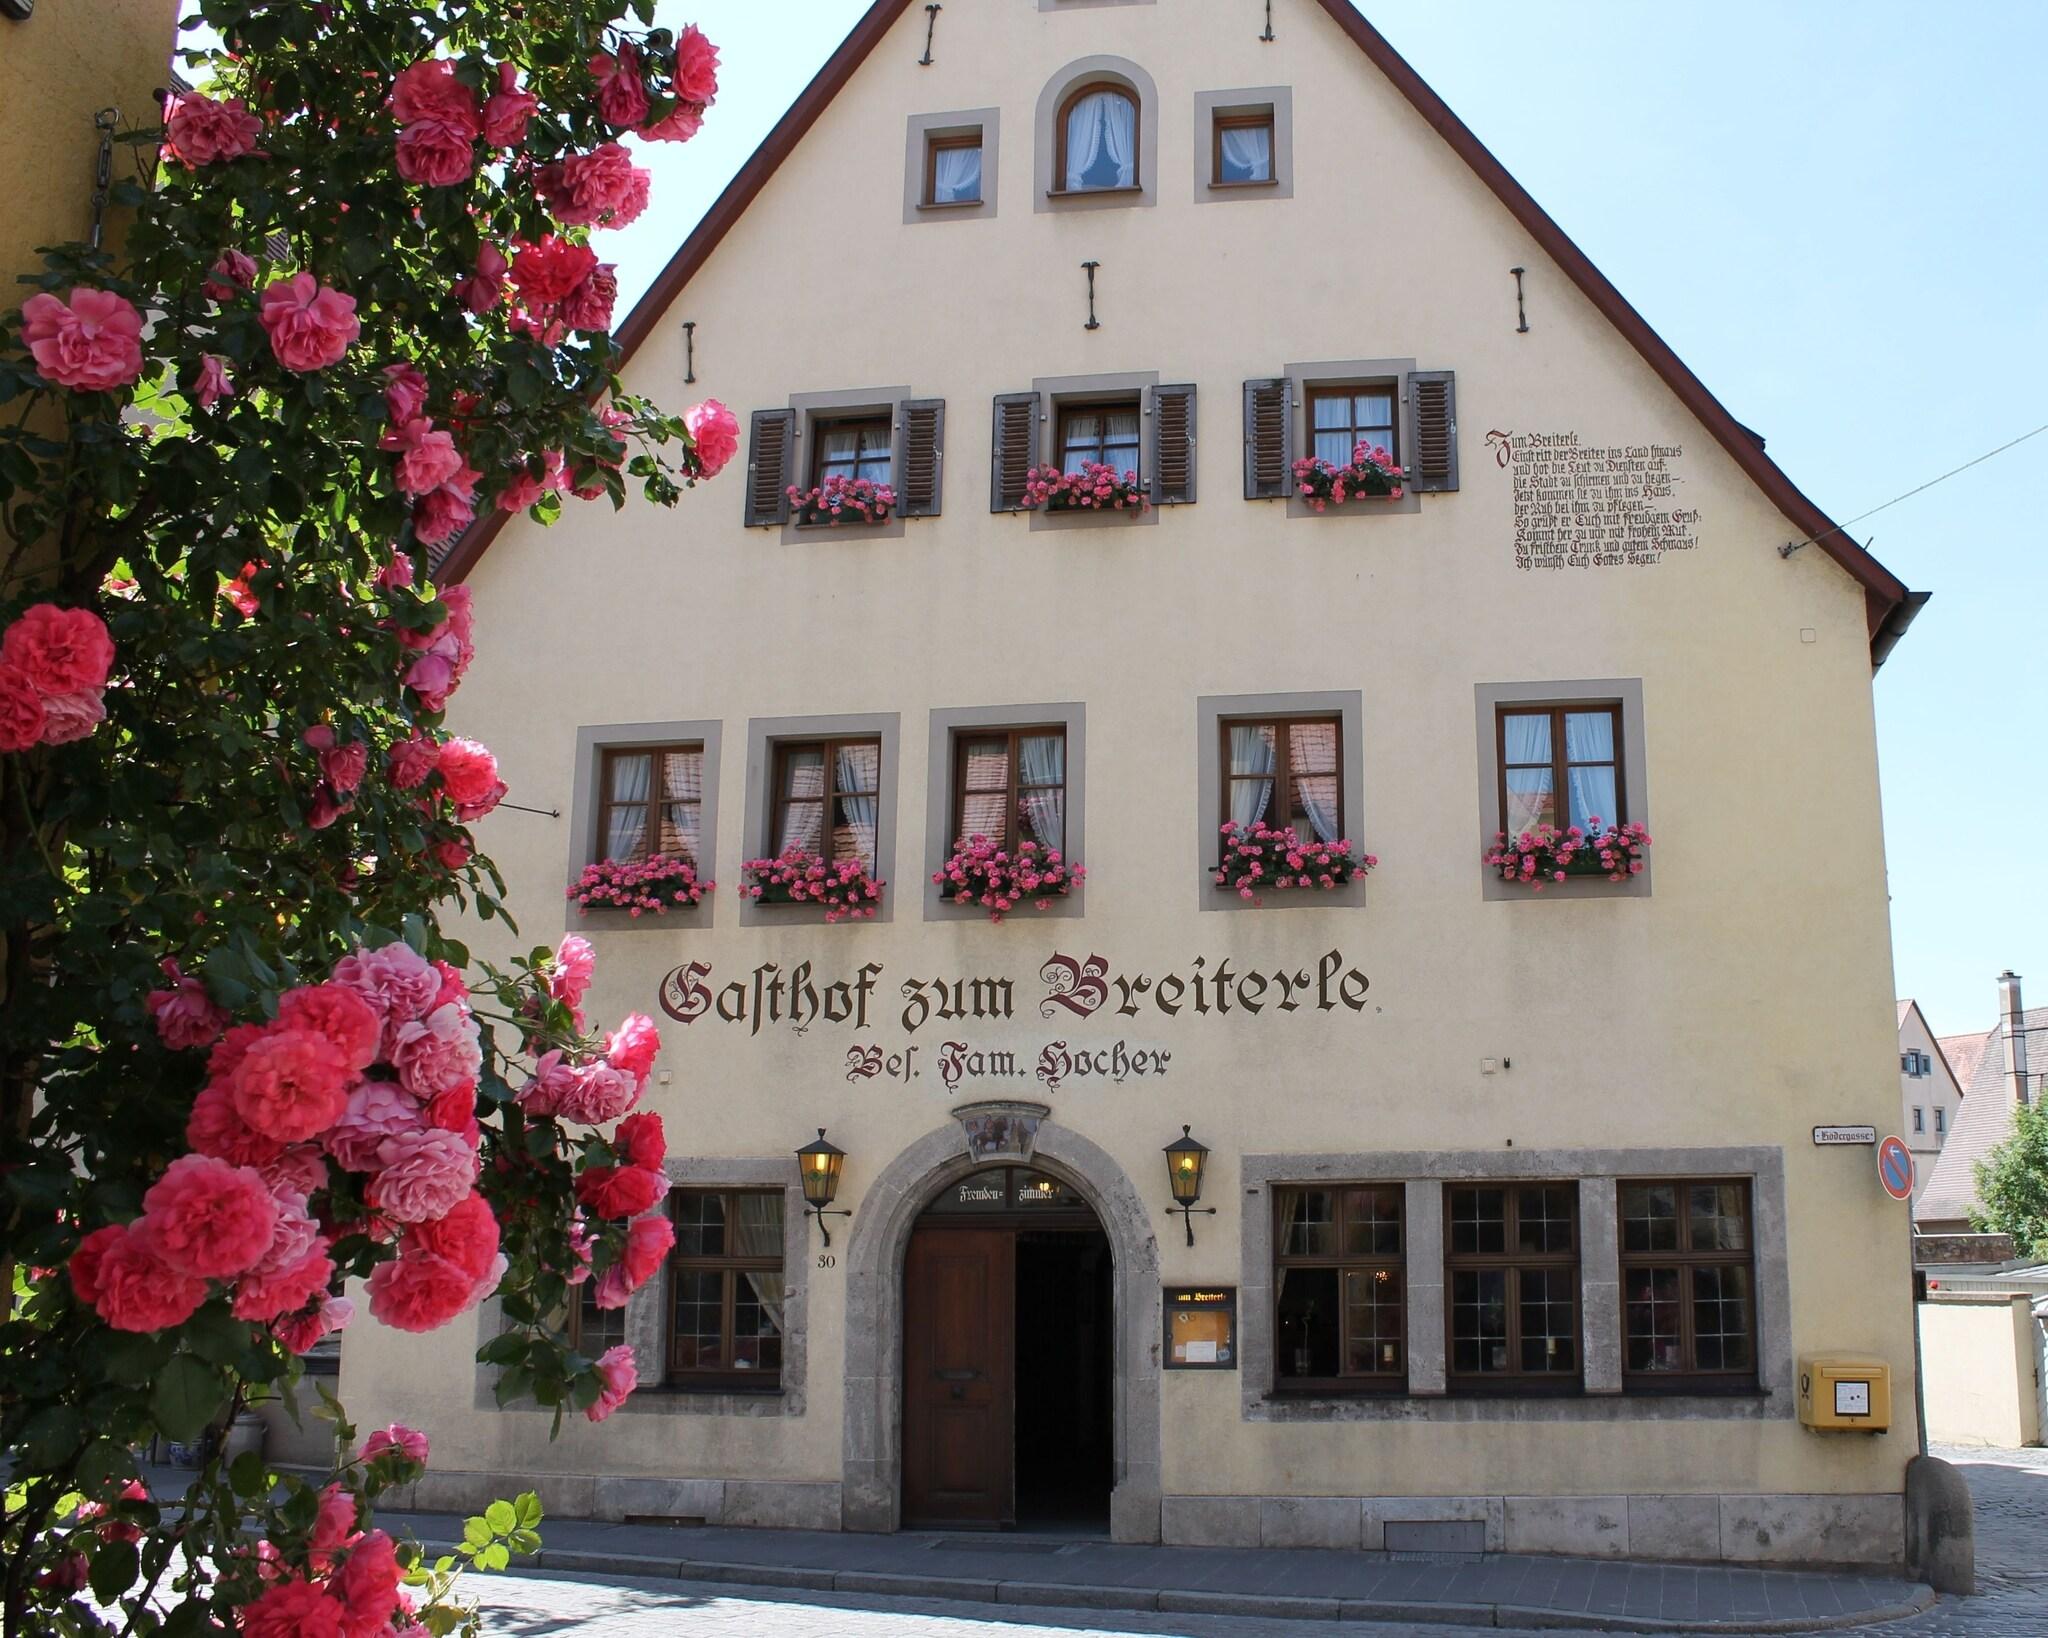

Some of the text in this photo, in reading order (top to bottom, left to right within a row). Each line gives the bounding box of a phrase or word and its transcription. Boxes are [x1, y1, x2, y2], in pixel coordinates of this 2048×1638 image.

[1484, 429, 1527, 469] Zum
[1554, 450, 1569, 461] der
[1568, 447, 1605, 461] Breiter
[1608, 446, 1623, 459] ins
[1624, 446, 1649, 459] Land
[1513, 464, 1531, 476] und
[1552, 462, 1566, 474] die
[1593, 462, 1605, 472] zu
[1605, 459, 1646, 473] Diensten
[1513, 476, 1527, 489] die
[1529, 475, 1558, 489] Stadt
[1561, 477, 1571, 488] zu
[1613, 473, 1629, 485] und
[1631, 474, 1642, 484] zu
[1591, 488, 1602, 499] zu
[1605, 486, 1622, 501] ihm
[1625, 486, 1639, 498] ins
[1514, 503, 1529, 515] der
[1555, 501, 1569, 514] bei
[1572, 500, 1589, 515] ihm
[1593, 501, 1604, 512] zu
[1514, 514, 1529, 528] So
[1561, 516, 1572, 527] er
[1575, 513, 1601, 528] Euch
[1604, 514, 1620, 525] mit
[1575, 529, 1587, 540] zu
[1570, 540, 1601, 553] Trunk
[1604, 539, 1620, 552] und
[1622, 540, 1649, 553] gutem
[1515, 555, 1532, 571] Ich
[1567, 554, 1590, 569] Euch
[1593, 552, 1624, 567] Gottes
[901, 975, 1015, 1035] zum
[1039, 947, 1370, 1021] Breiterle
[938, 1041, 1026, 1094] Fam.
[1036, 1039, 1172, 1094] Hocher
[817, 1254, 836, 1269] 30
